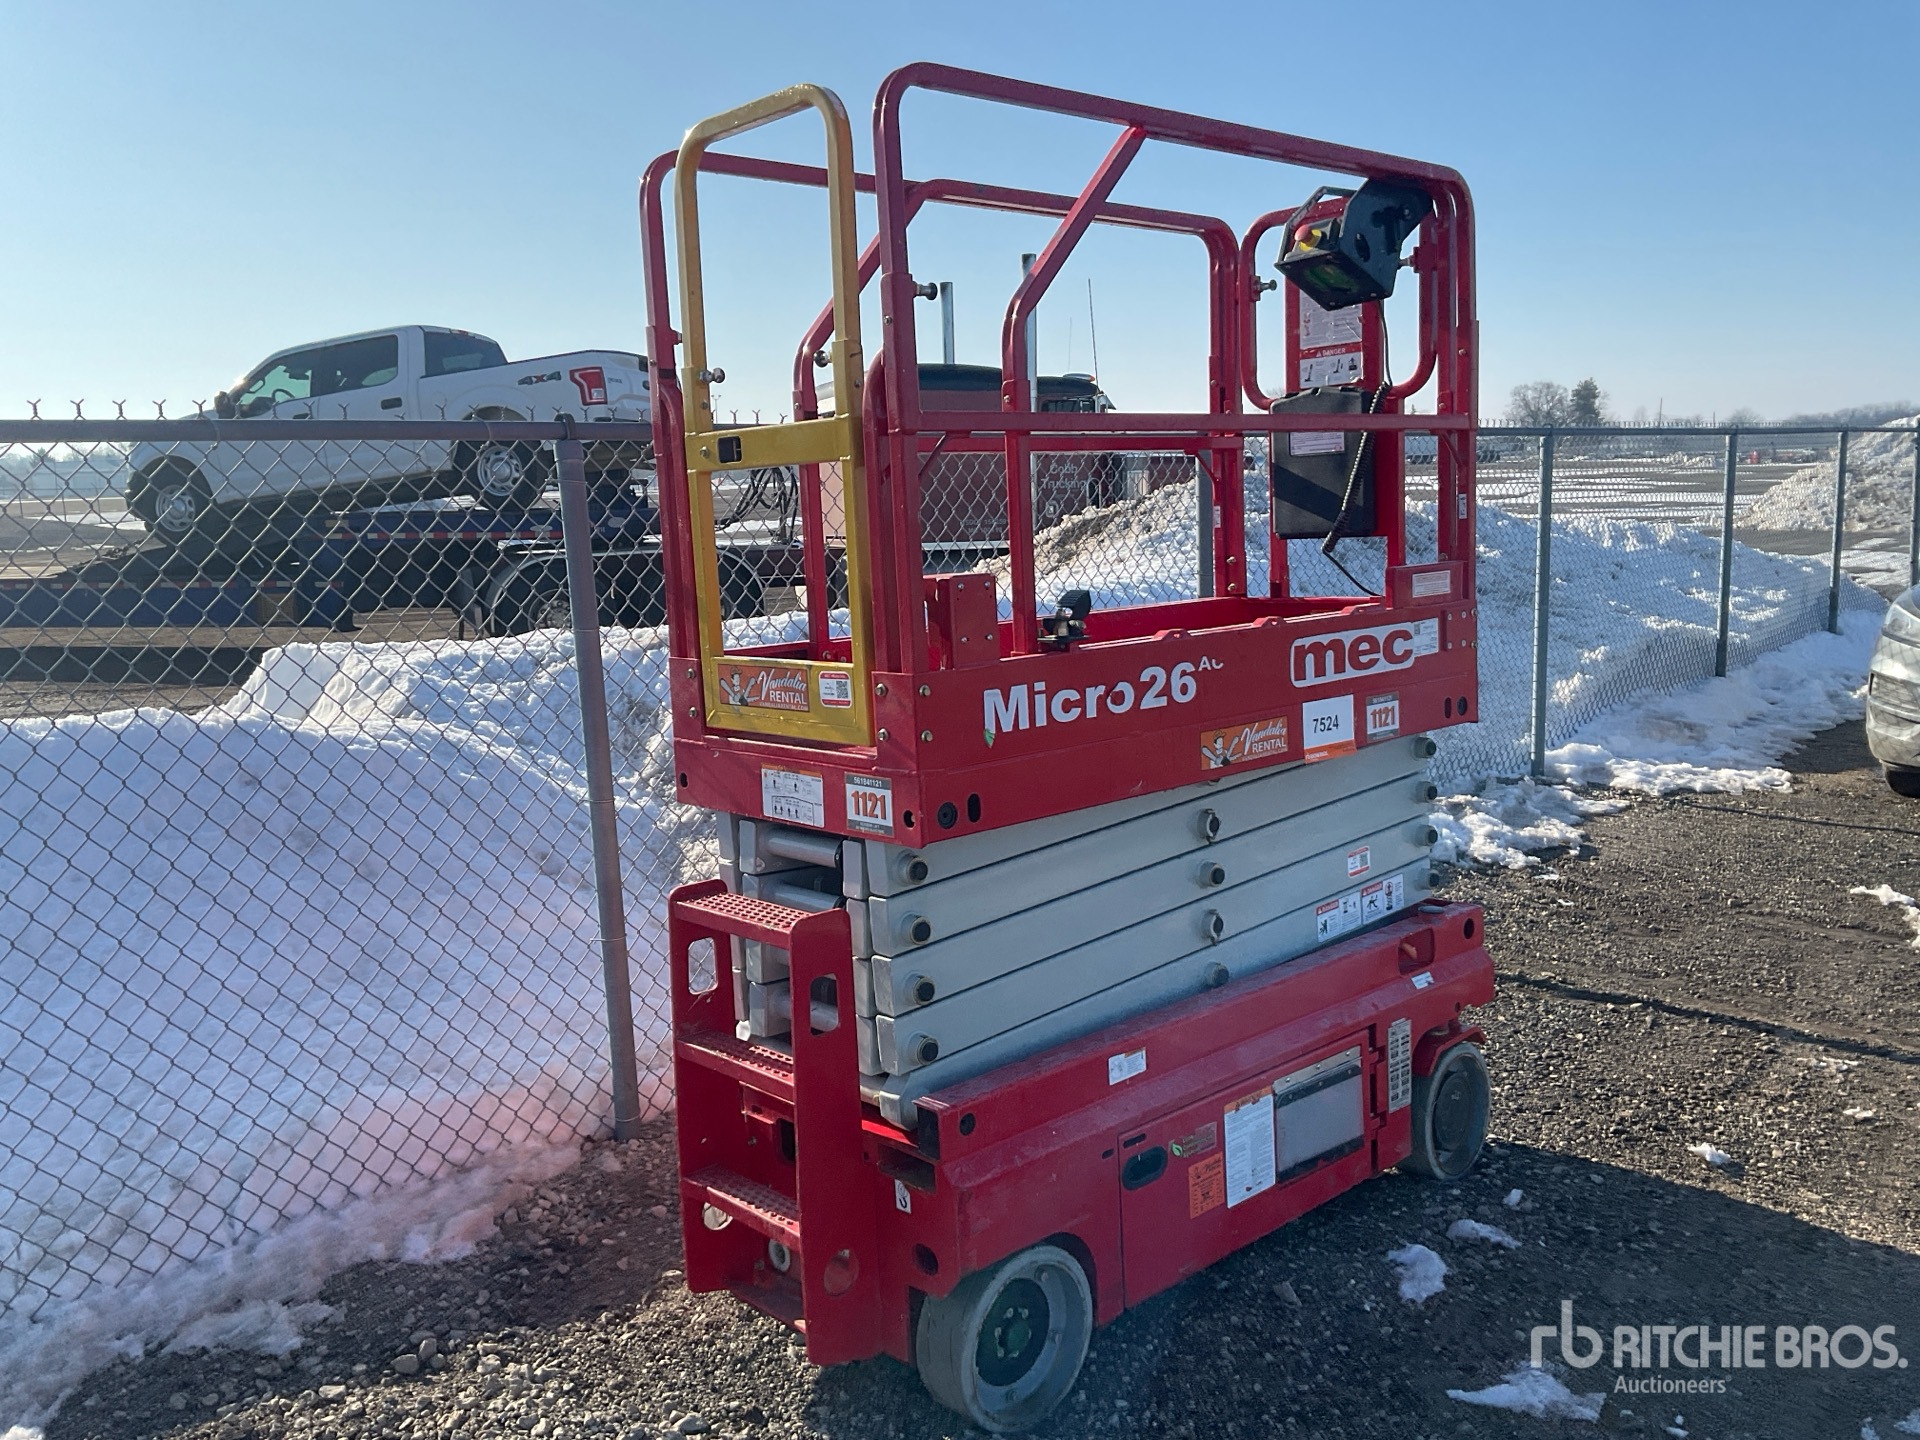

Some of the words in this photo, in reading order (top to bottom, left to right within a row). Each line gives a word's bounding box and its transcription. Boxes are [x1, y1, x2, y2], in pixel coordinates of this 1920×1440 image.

[1322, 348, 1346, 357] DANGER
[1293, 629, 1414, 682] mec
[757, 669, 807, 701] Vandalia
[769, 690, 808, 705] RENTAL
[983, 662, 1197, 740] Micro26
[1312, 714, 1339, 734] 7524
[1370, 705, 1395, 729] 1121
[1240, 719, 1287, 755] Vandalia
[1252, 738, 1287, 753] RENTAL
[851, 790, 887, 820] 1121
